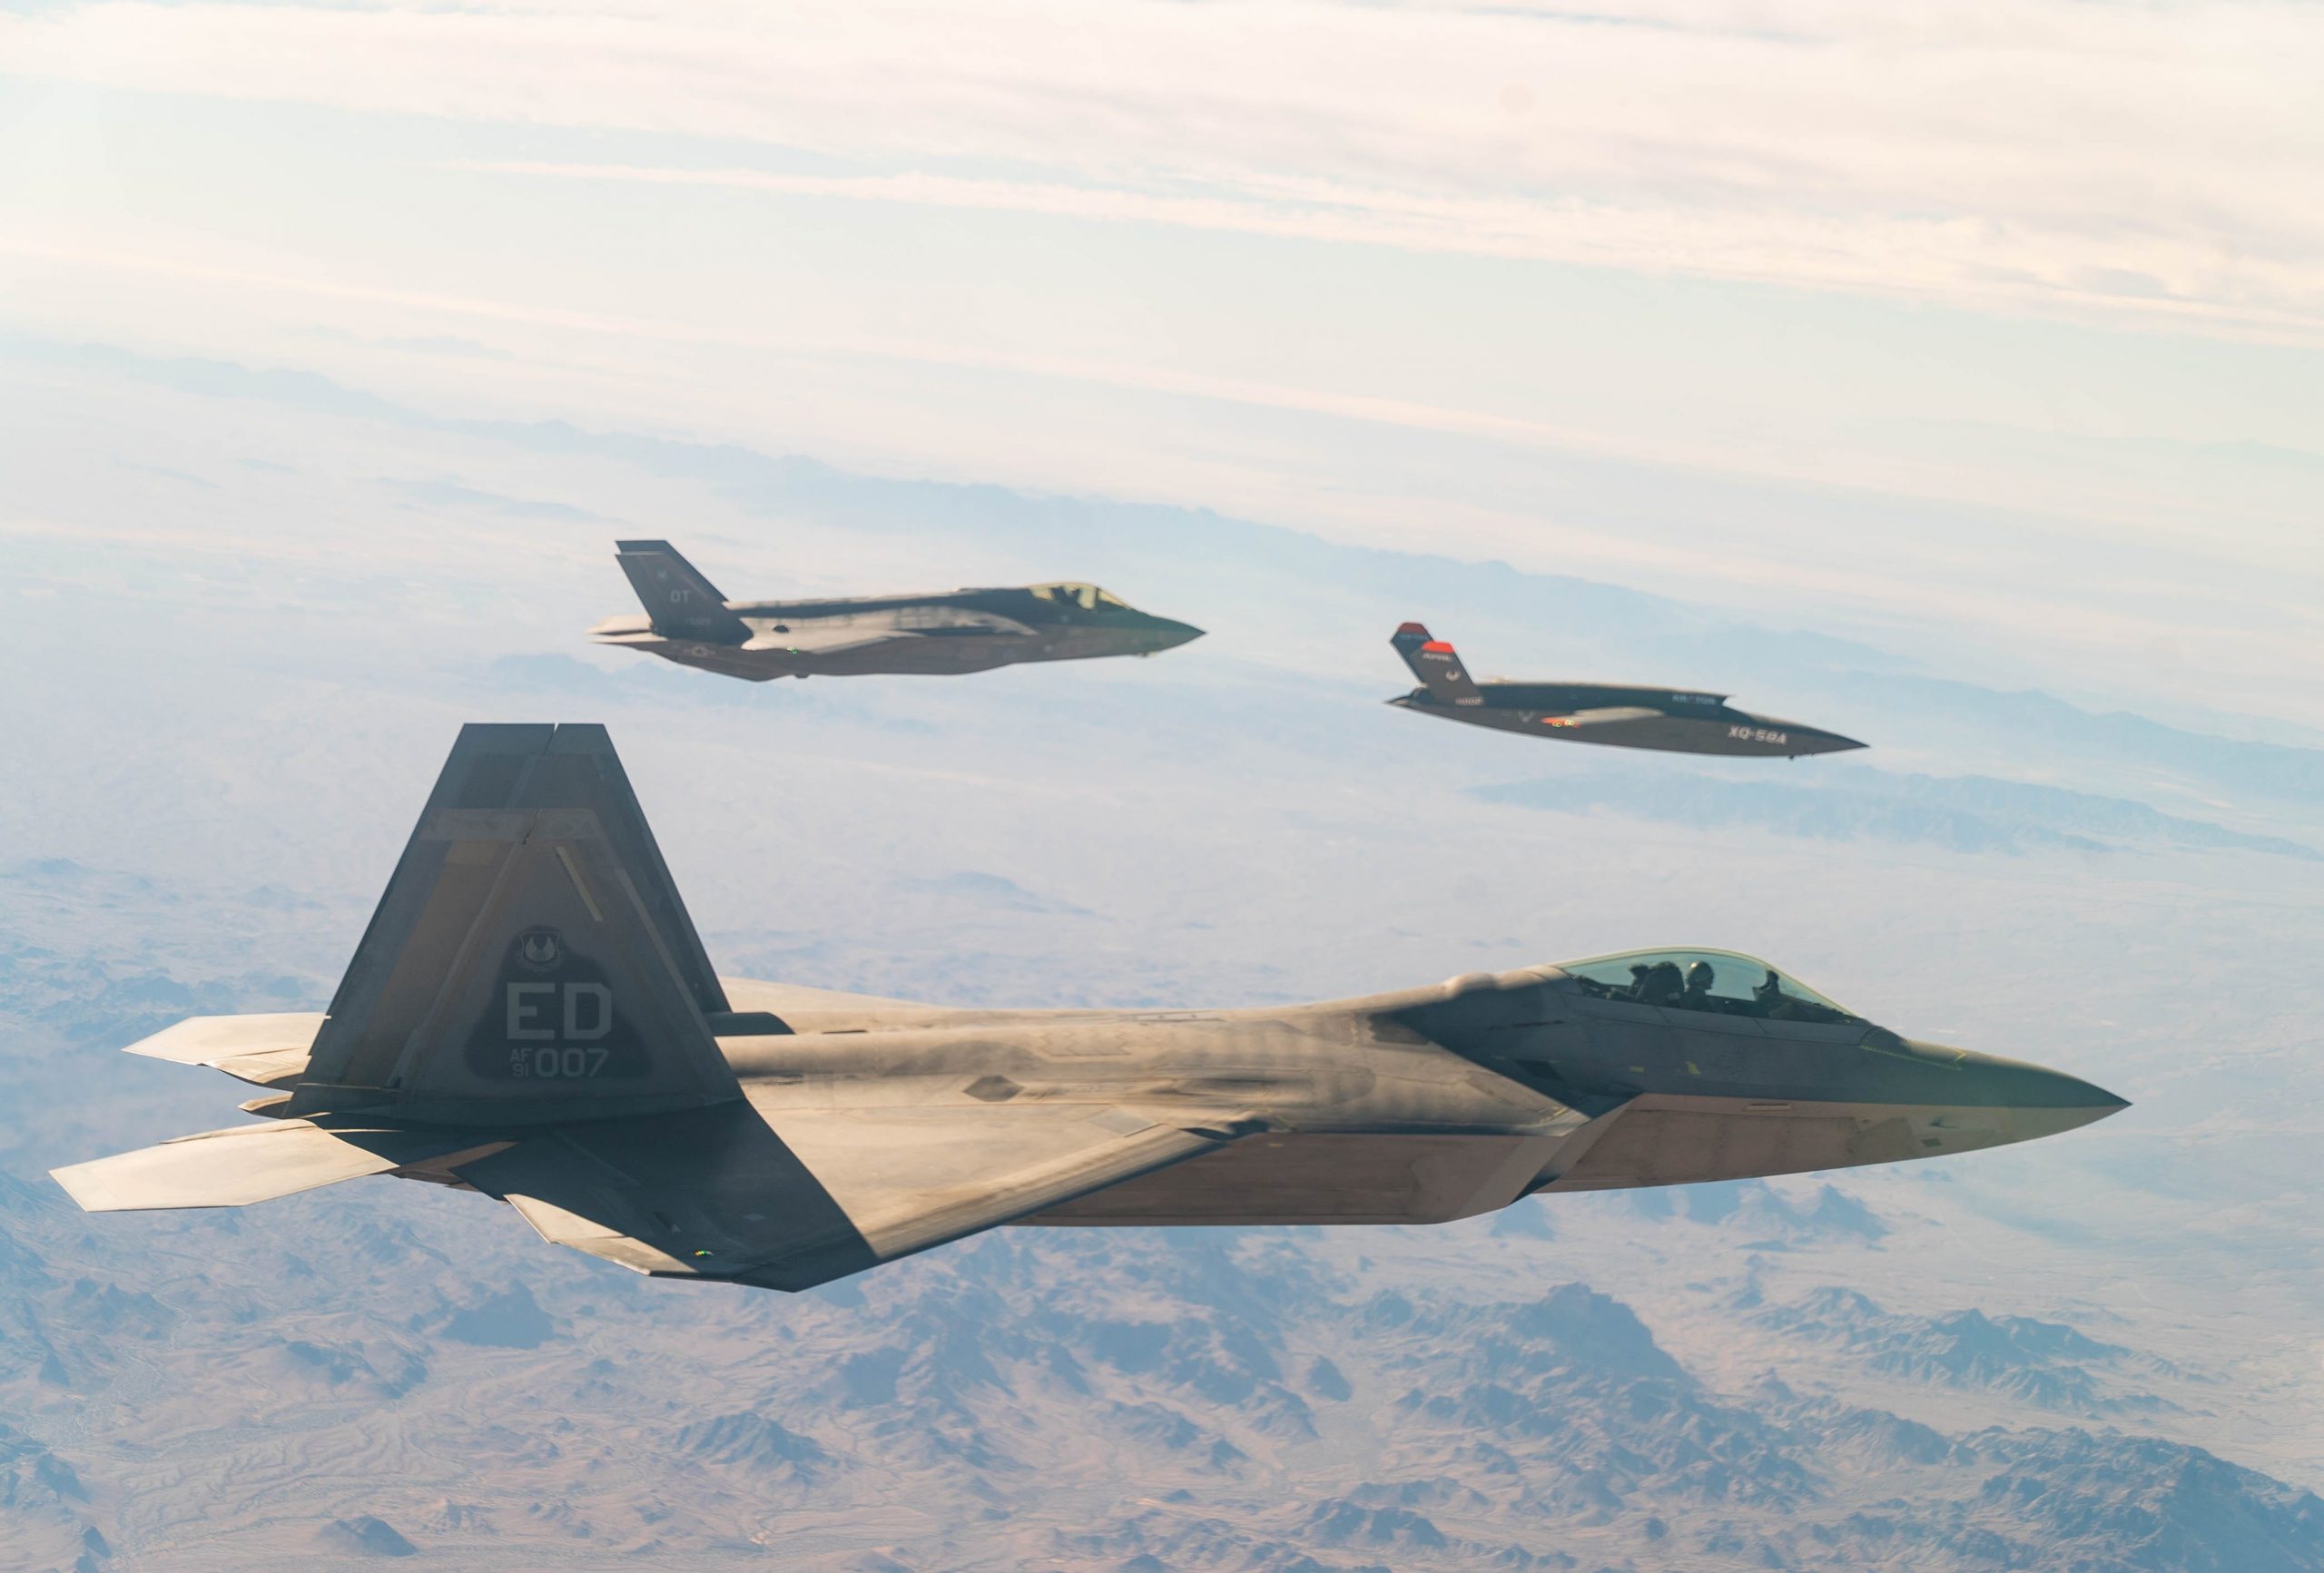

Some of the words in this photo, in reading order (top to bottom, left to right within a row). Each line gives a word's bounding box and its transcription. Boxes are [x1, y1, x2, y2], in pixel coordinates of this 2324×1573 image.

[670, 589, 690, 604] OT
[1728, 725, 1787, 745] XQ-58A
[507, 982, 612, 1039] ED
[510, 1047, 532, 1062] AF
[535, 1047, 609, 1077] 007
[513, 1063, 528, 1077] 91
